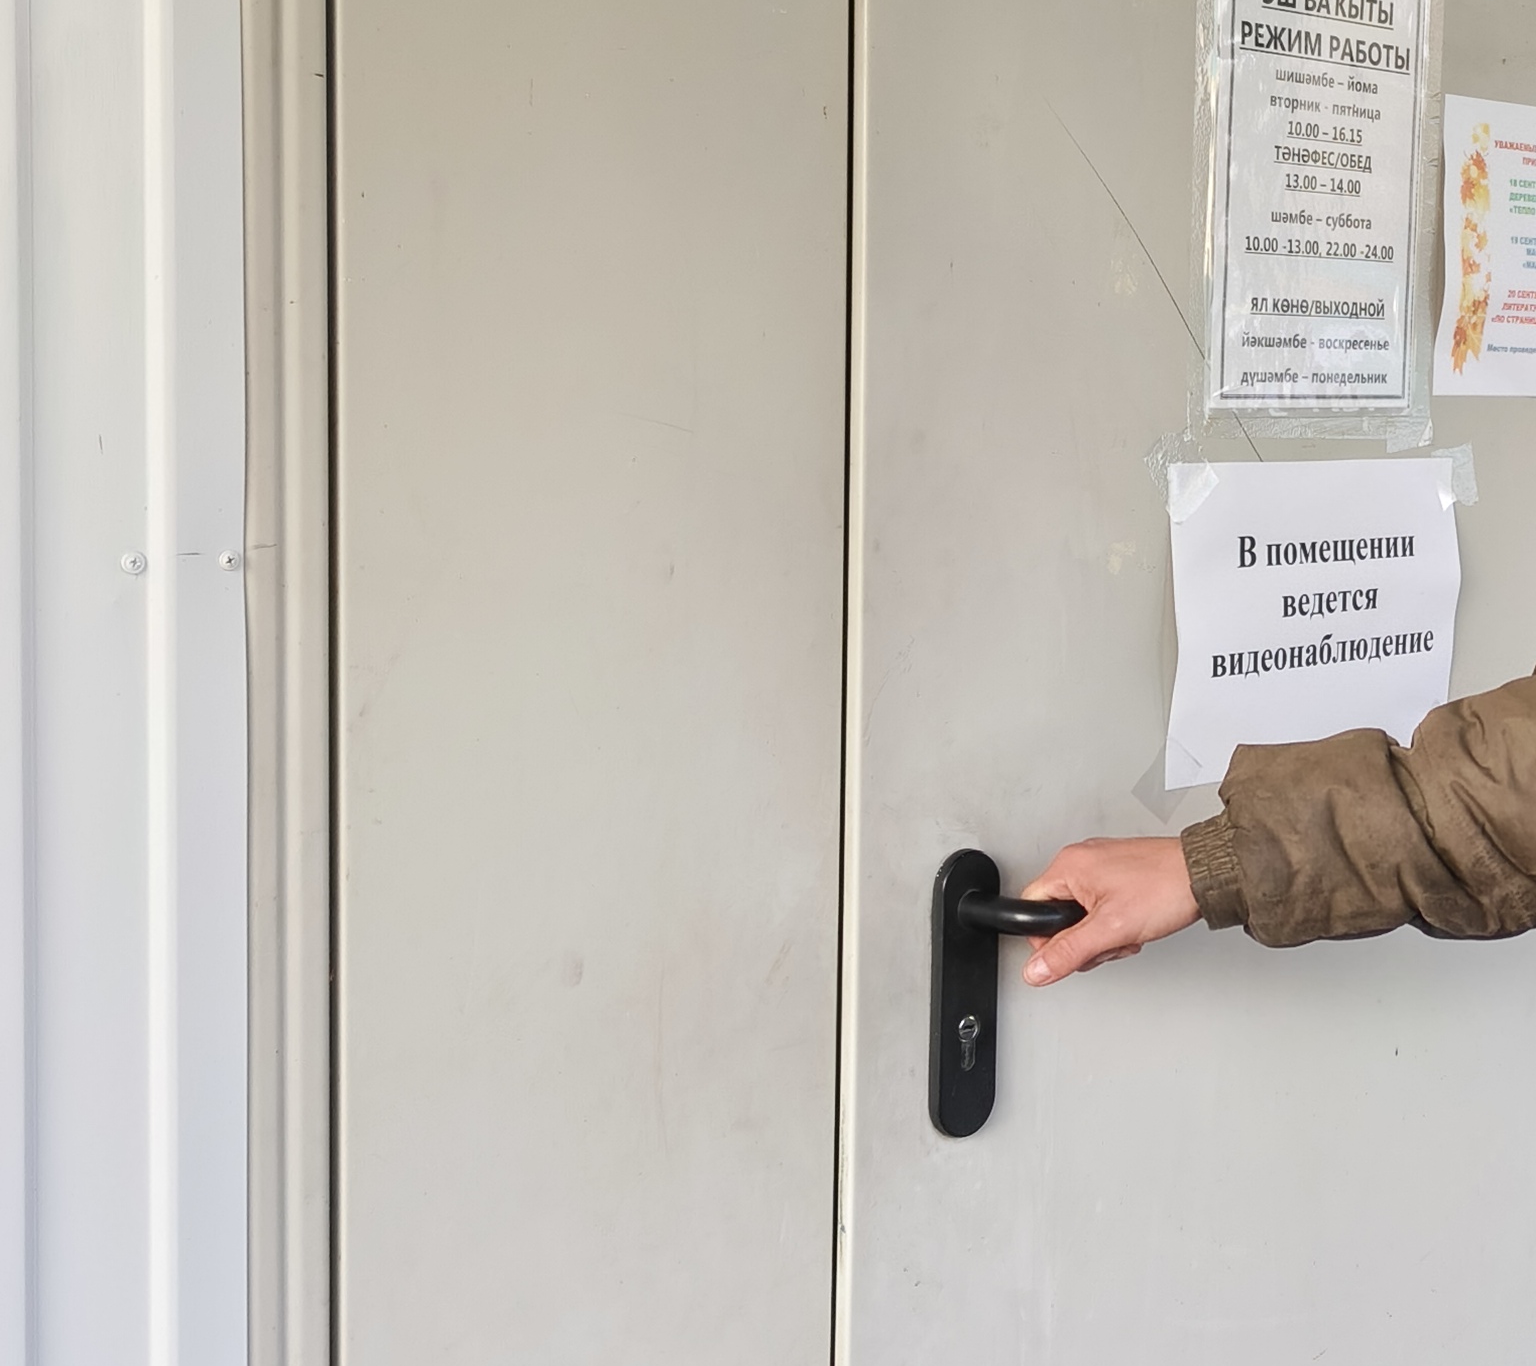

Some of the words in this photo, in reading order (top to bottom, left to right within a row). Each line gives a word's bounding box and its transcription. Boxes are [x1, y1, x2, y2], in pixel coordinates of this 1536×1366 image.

[1240, 20, 1322, 57] РЕЖИМ
[1329, 35, 1410, 71] РАБОТЫ
[1276, 68, 1335, 88] шишәмбе
[1347, 76, 1378, 95] йома
[1270, 95, 1321, 113] вторник
[1332, 104, 1381, 123] пятница
[1288, 121, 1320, 138] 10.00
[1332, 127, 1363, 144] 16.15
[1274, 145, 1372, 173] ТӘНӘФЕС/ОБЕД
[1286, 174, 1317, 190] 13.00
[1330, 178, 1361, 194] 14.00
[1271, 210, 1313, 225] шәмбе
[1325, 214, 1372, 231] суббота
[1245, 236, 1278, 252] 10.00
[1326, 242, 1357, 258] 22.00
[1507, 290, 1516, 298] 20
[1251, 298, 1268, 312] ЯЛ
[1272, 298, 1385, 319] КӨНӨ/ВЫХОДНОЙ
[1242, 332, 1307, 349] йәкшәмбе
[1318, 337, 1389, 352] воскресенье
[1487, 344, 1508, 353] Место
[1311, 371, 1387, 386] понедельник
[1237, 535, 1257, 568] В
[1265, 535, 1415, 567] помещении
[1282, 587, 1379, 619] ведется
[1211, 629, 1434, 678] видеонаблюдение
